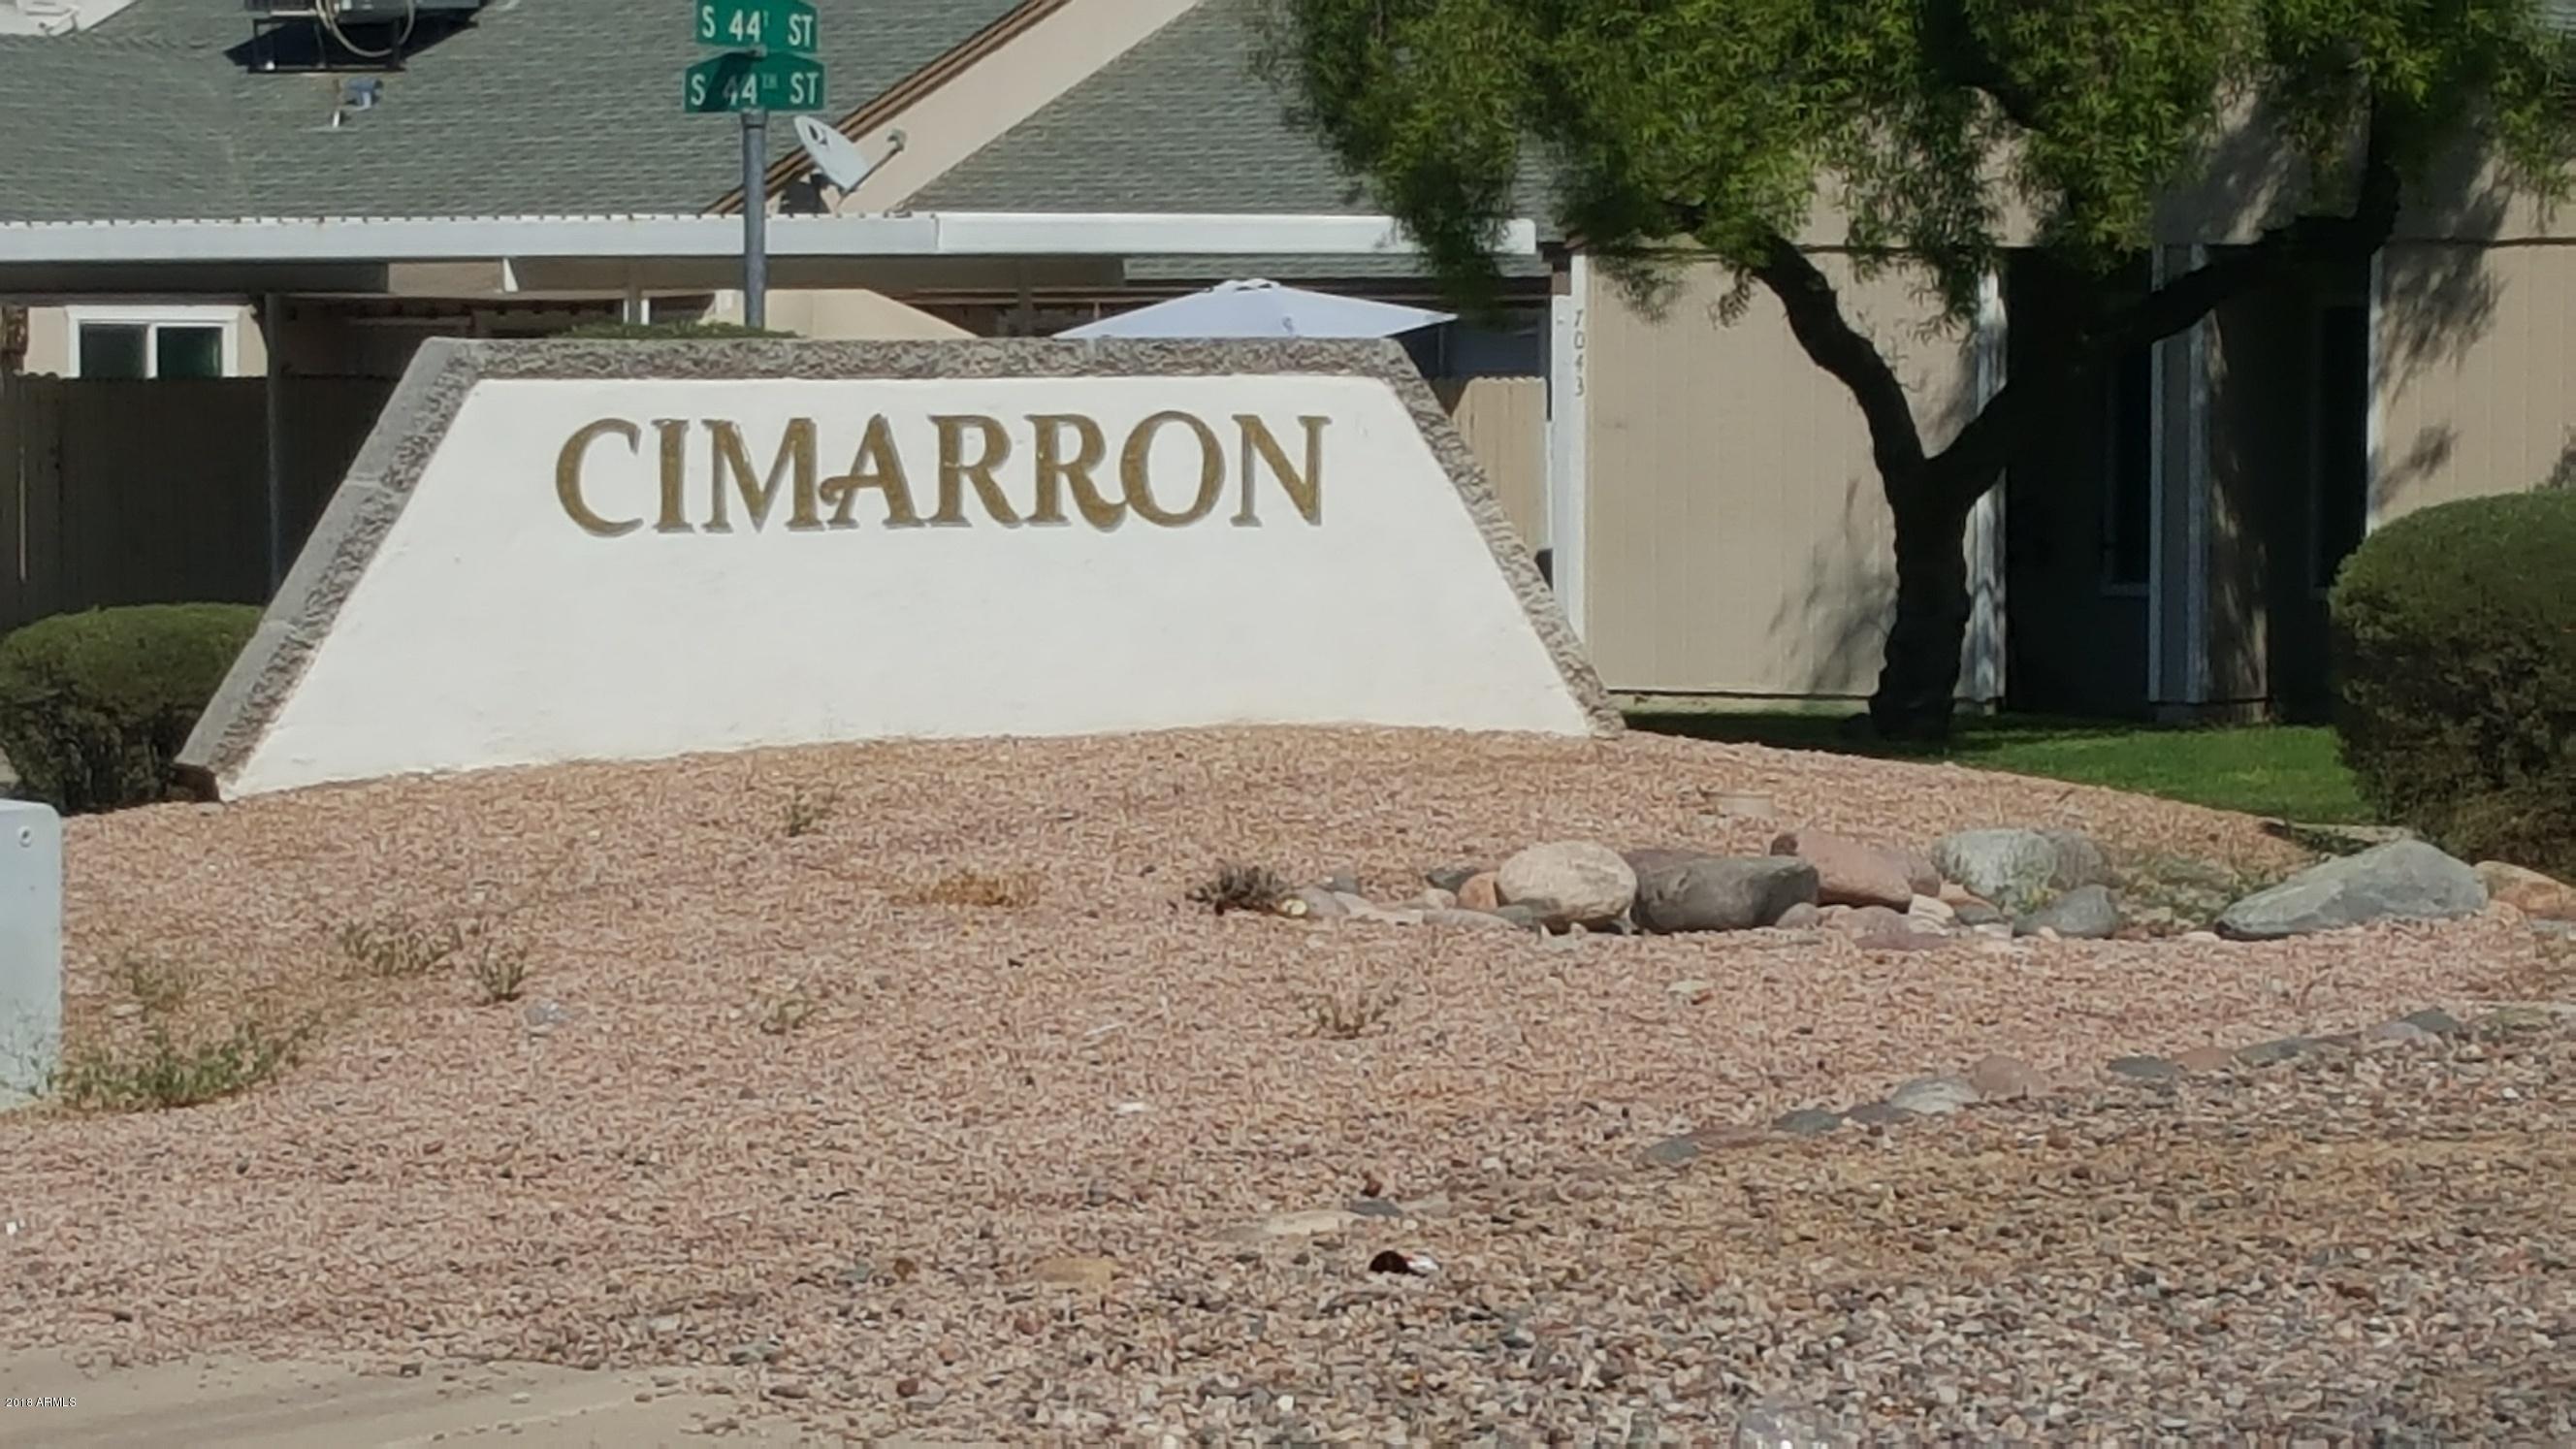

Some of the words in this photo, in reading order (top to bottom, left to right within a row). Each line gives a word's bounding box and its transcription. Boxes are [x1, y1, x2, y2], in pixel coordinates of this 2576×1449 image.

[701, 5, 716, 39] S
[788, 13, 814, 47] ST
[691, 73, 706, 106] S
[789, 71, 820, 106] ST
[555, 410, 1333, 537] CIMARRON
